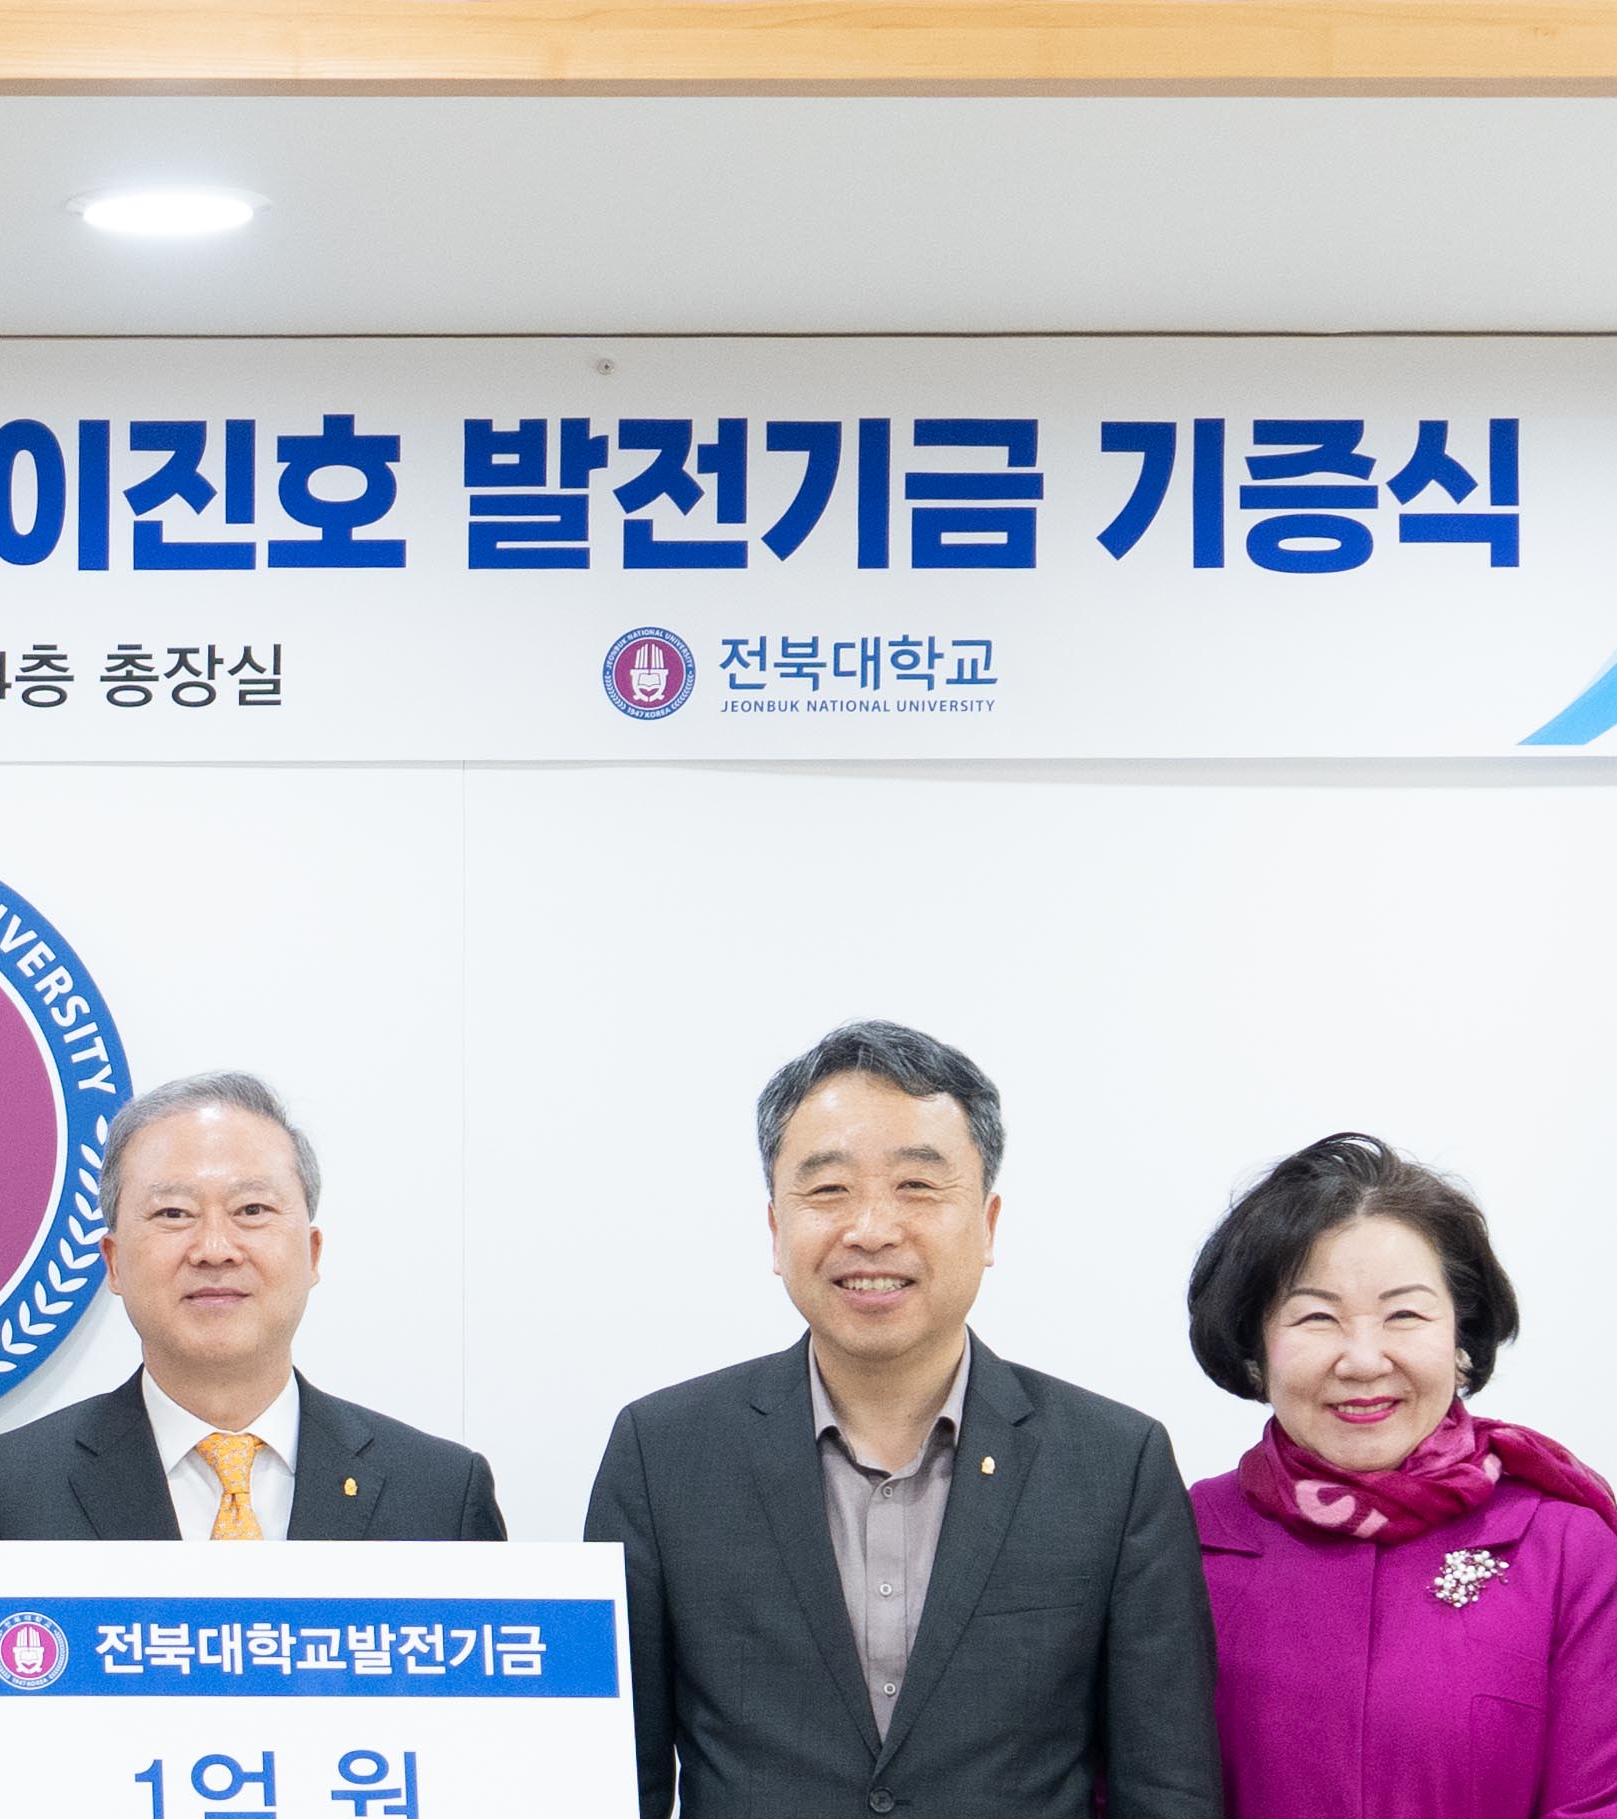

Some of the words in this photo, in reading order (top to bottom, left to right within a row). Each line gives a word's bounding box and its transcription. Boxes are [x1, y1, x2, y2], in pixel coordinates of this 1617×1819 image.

[462, 416, 1045, 571] 발전기금
[1095, 416, 1521, 575] 기증식
[98, 643, 283, 709] 총장실
[718, 633, 999, 693] 전북대학교
[720, 699, 800, 714] JEONBUK
[806, 699, 891, 713] NATIONAL
[896, 699, 996, 713] UNIVERSITY
[94, 1621, 548, 1677] 전북대학교발전기금
